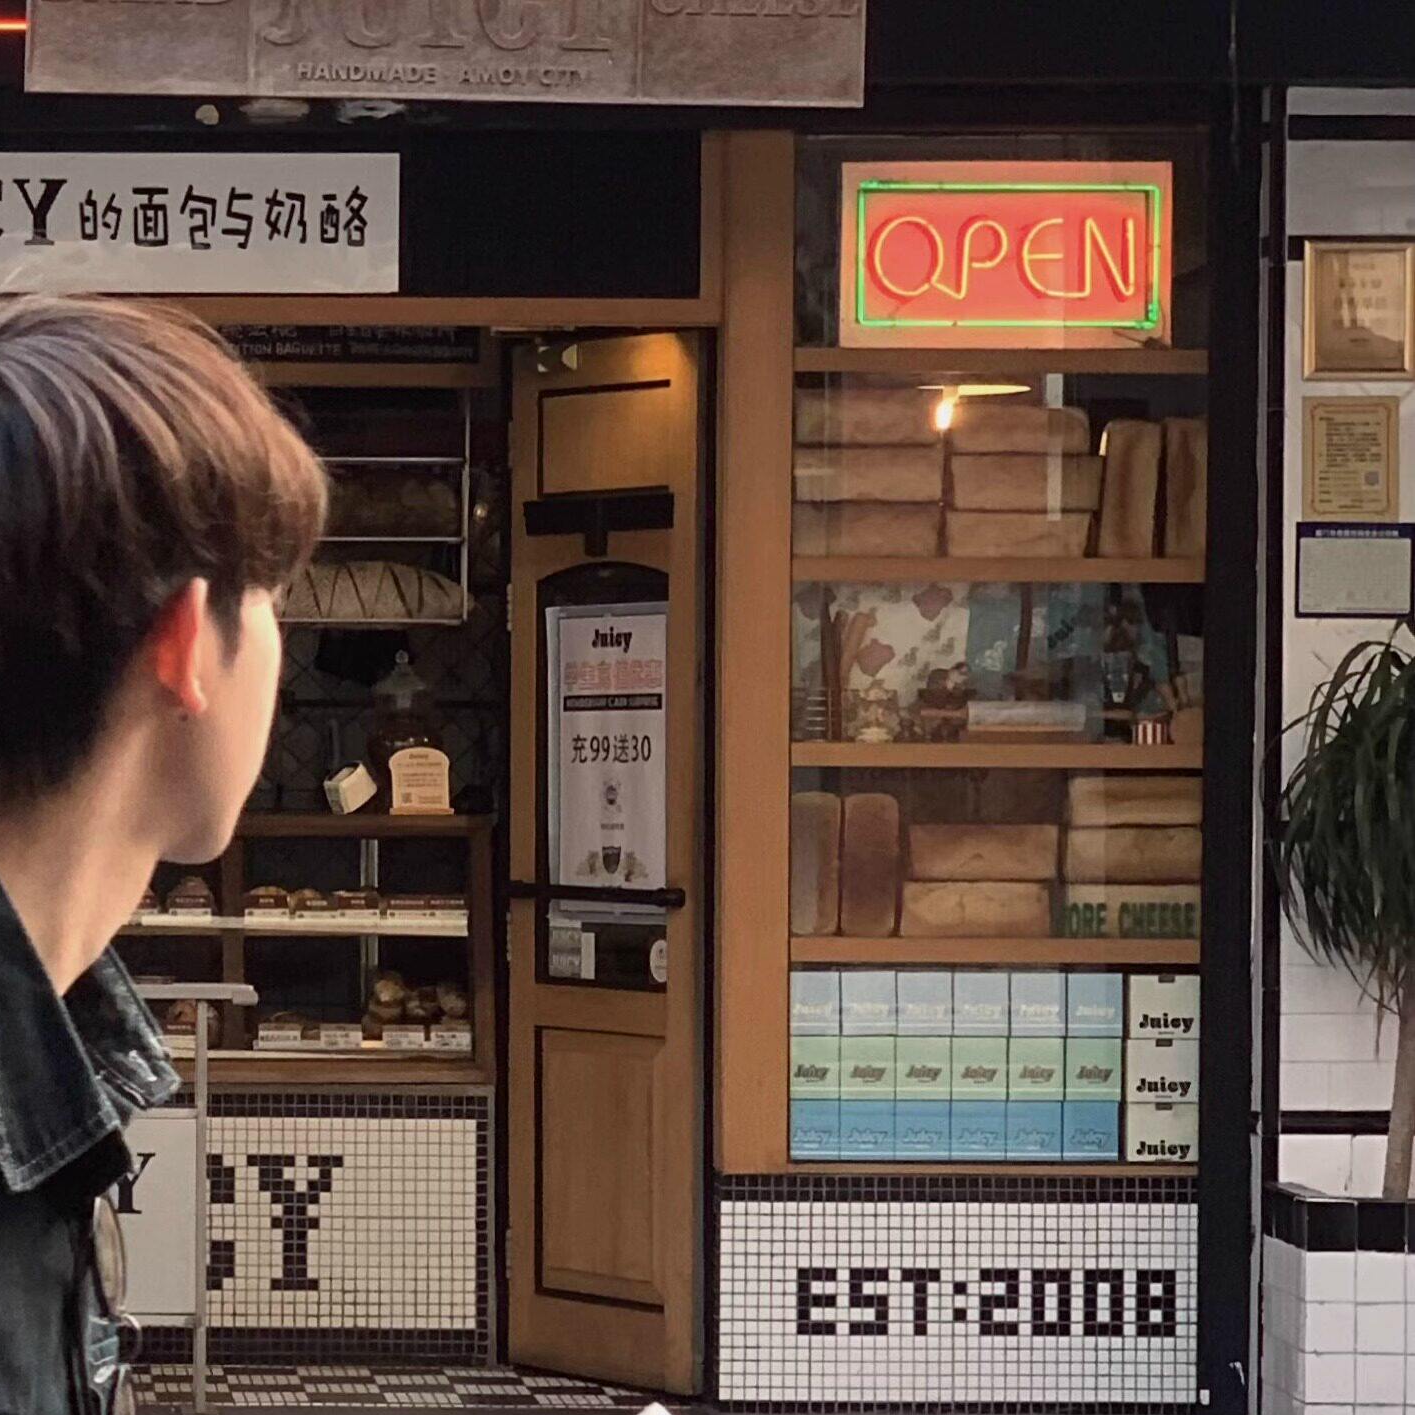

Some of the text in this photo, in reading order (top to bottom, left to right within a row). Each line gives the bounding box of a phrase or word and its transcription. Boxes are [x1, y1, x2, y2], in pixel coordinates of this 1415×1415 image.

[297, 62, 437, 84] HANDMADE
[78, 185, 369, 250] 的面包与奶酪
[871, 214, 1136, 301] OPEN
[591, 626, 632, 653] Juicy
[571, 733, 652, 764] 充99送30
[1139, 1012, 1195, 1034] Juicy
[1136, 1076, 1192, 1097] Juicy
[1136, 1139, 1191, 1160] Juicy
